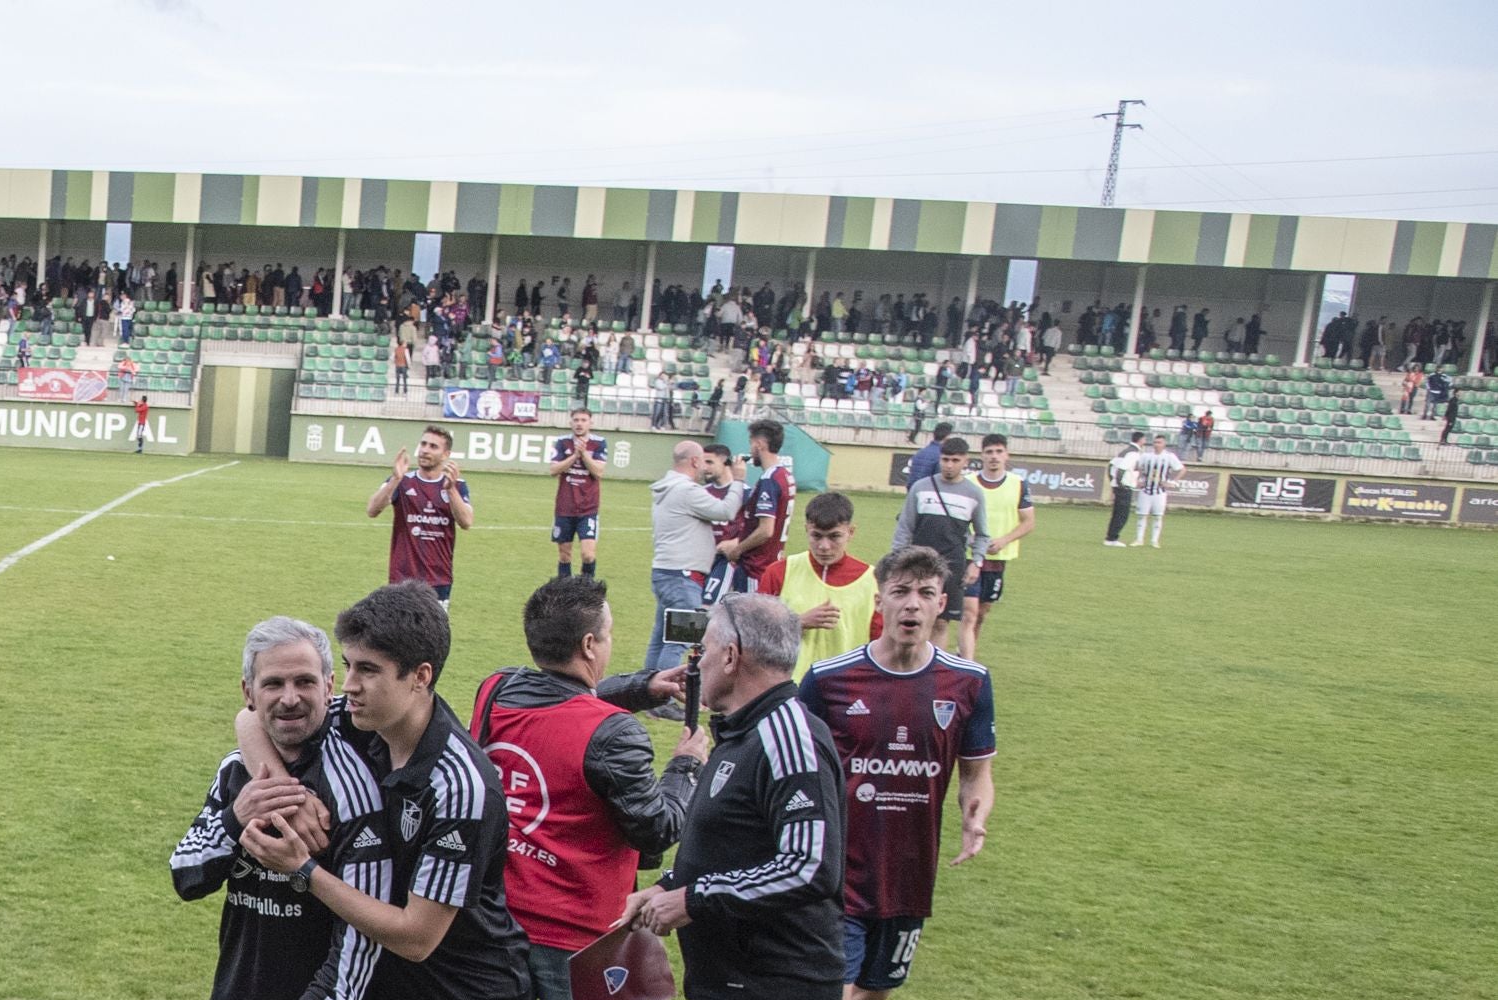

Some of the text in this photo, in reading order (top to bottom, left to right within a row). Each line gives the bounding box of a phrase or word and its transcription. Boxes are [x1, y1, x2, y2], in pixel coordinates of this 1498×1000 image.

[333, 423, 387, 456] LA
[1027, 469, 1095, 490] drylock
[352, 837, 382, 849] adidas
[436, 839, 467, 852] adidas
